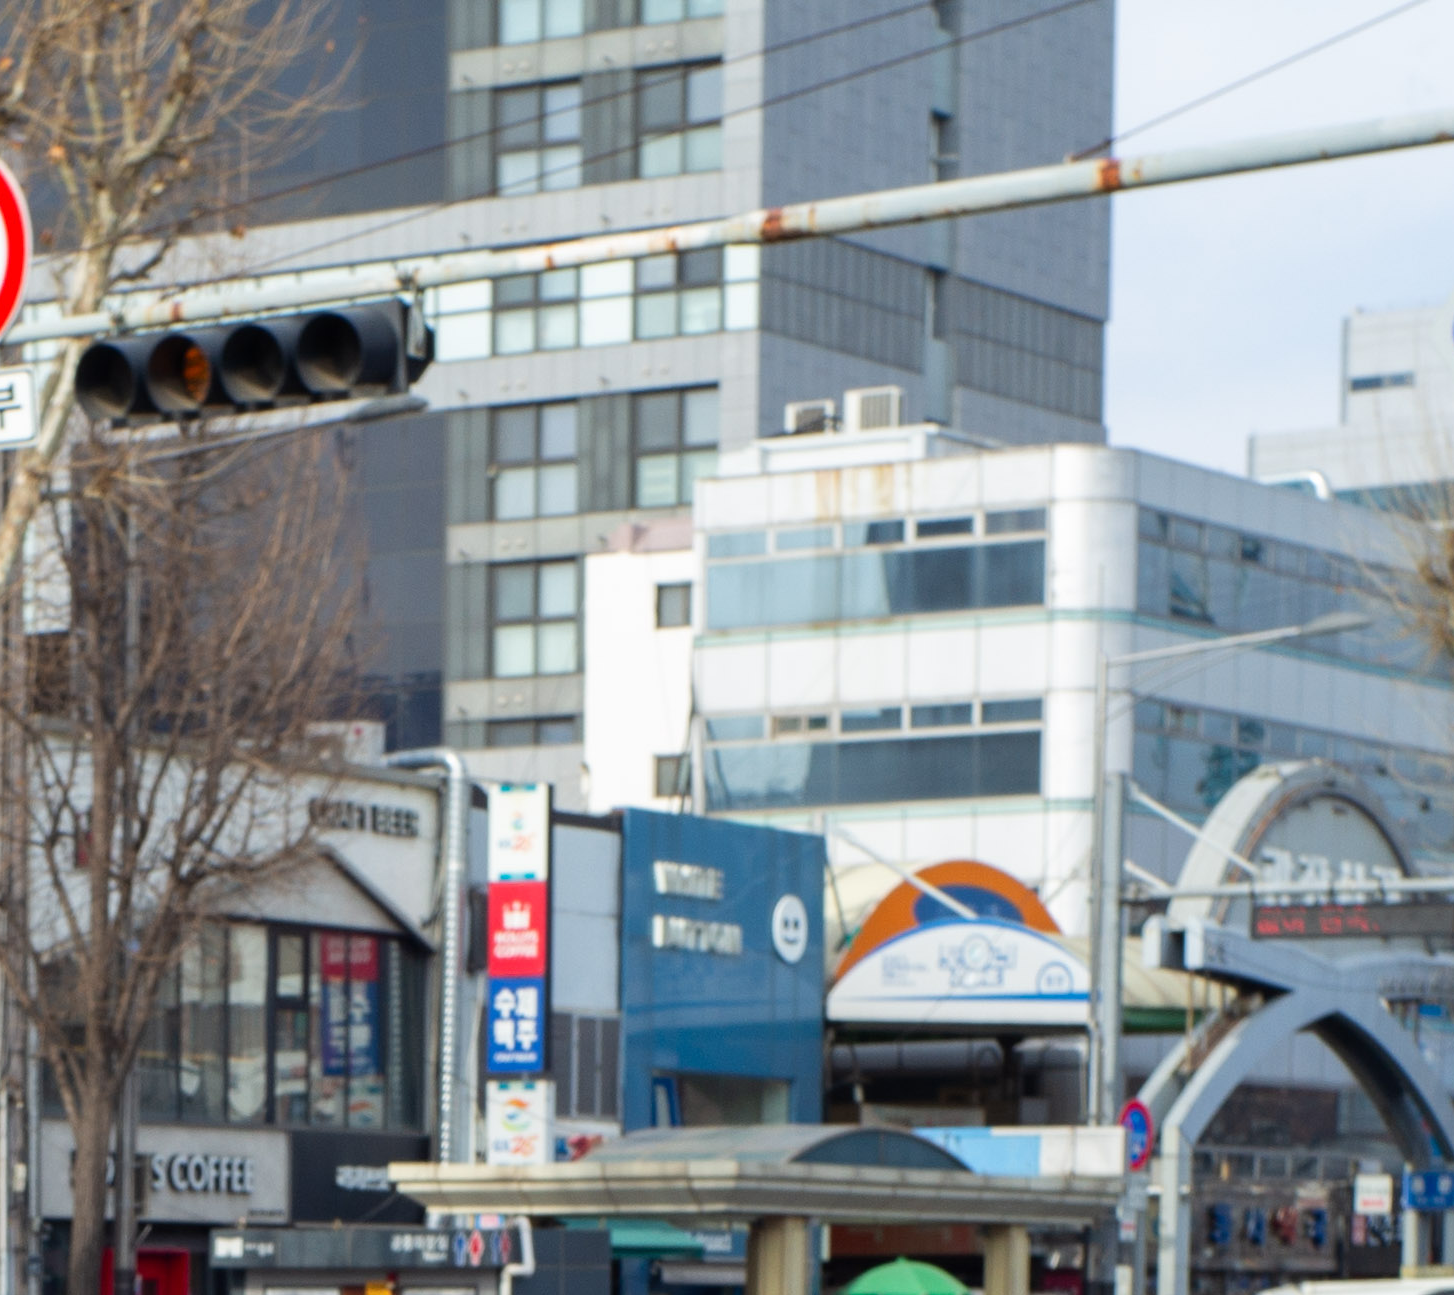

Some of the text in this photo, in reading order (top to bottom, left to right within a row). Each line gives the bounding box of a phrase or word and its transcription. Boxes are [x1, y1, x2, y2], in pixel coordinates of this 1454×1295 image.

[493, 987, 538, 1020] 수제
[493, 1020, 538, 1051] 맥주
[171, 1154, 256, 1195] COFFEE
